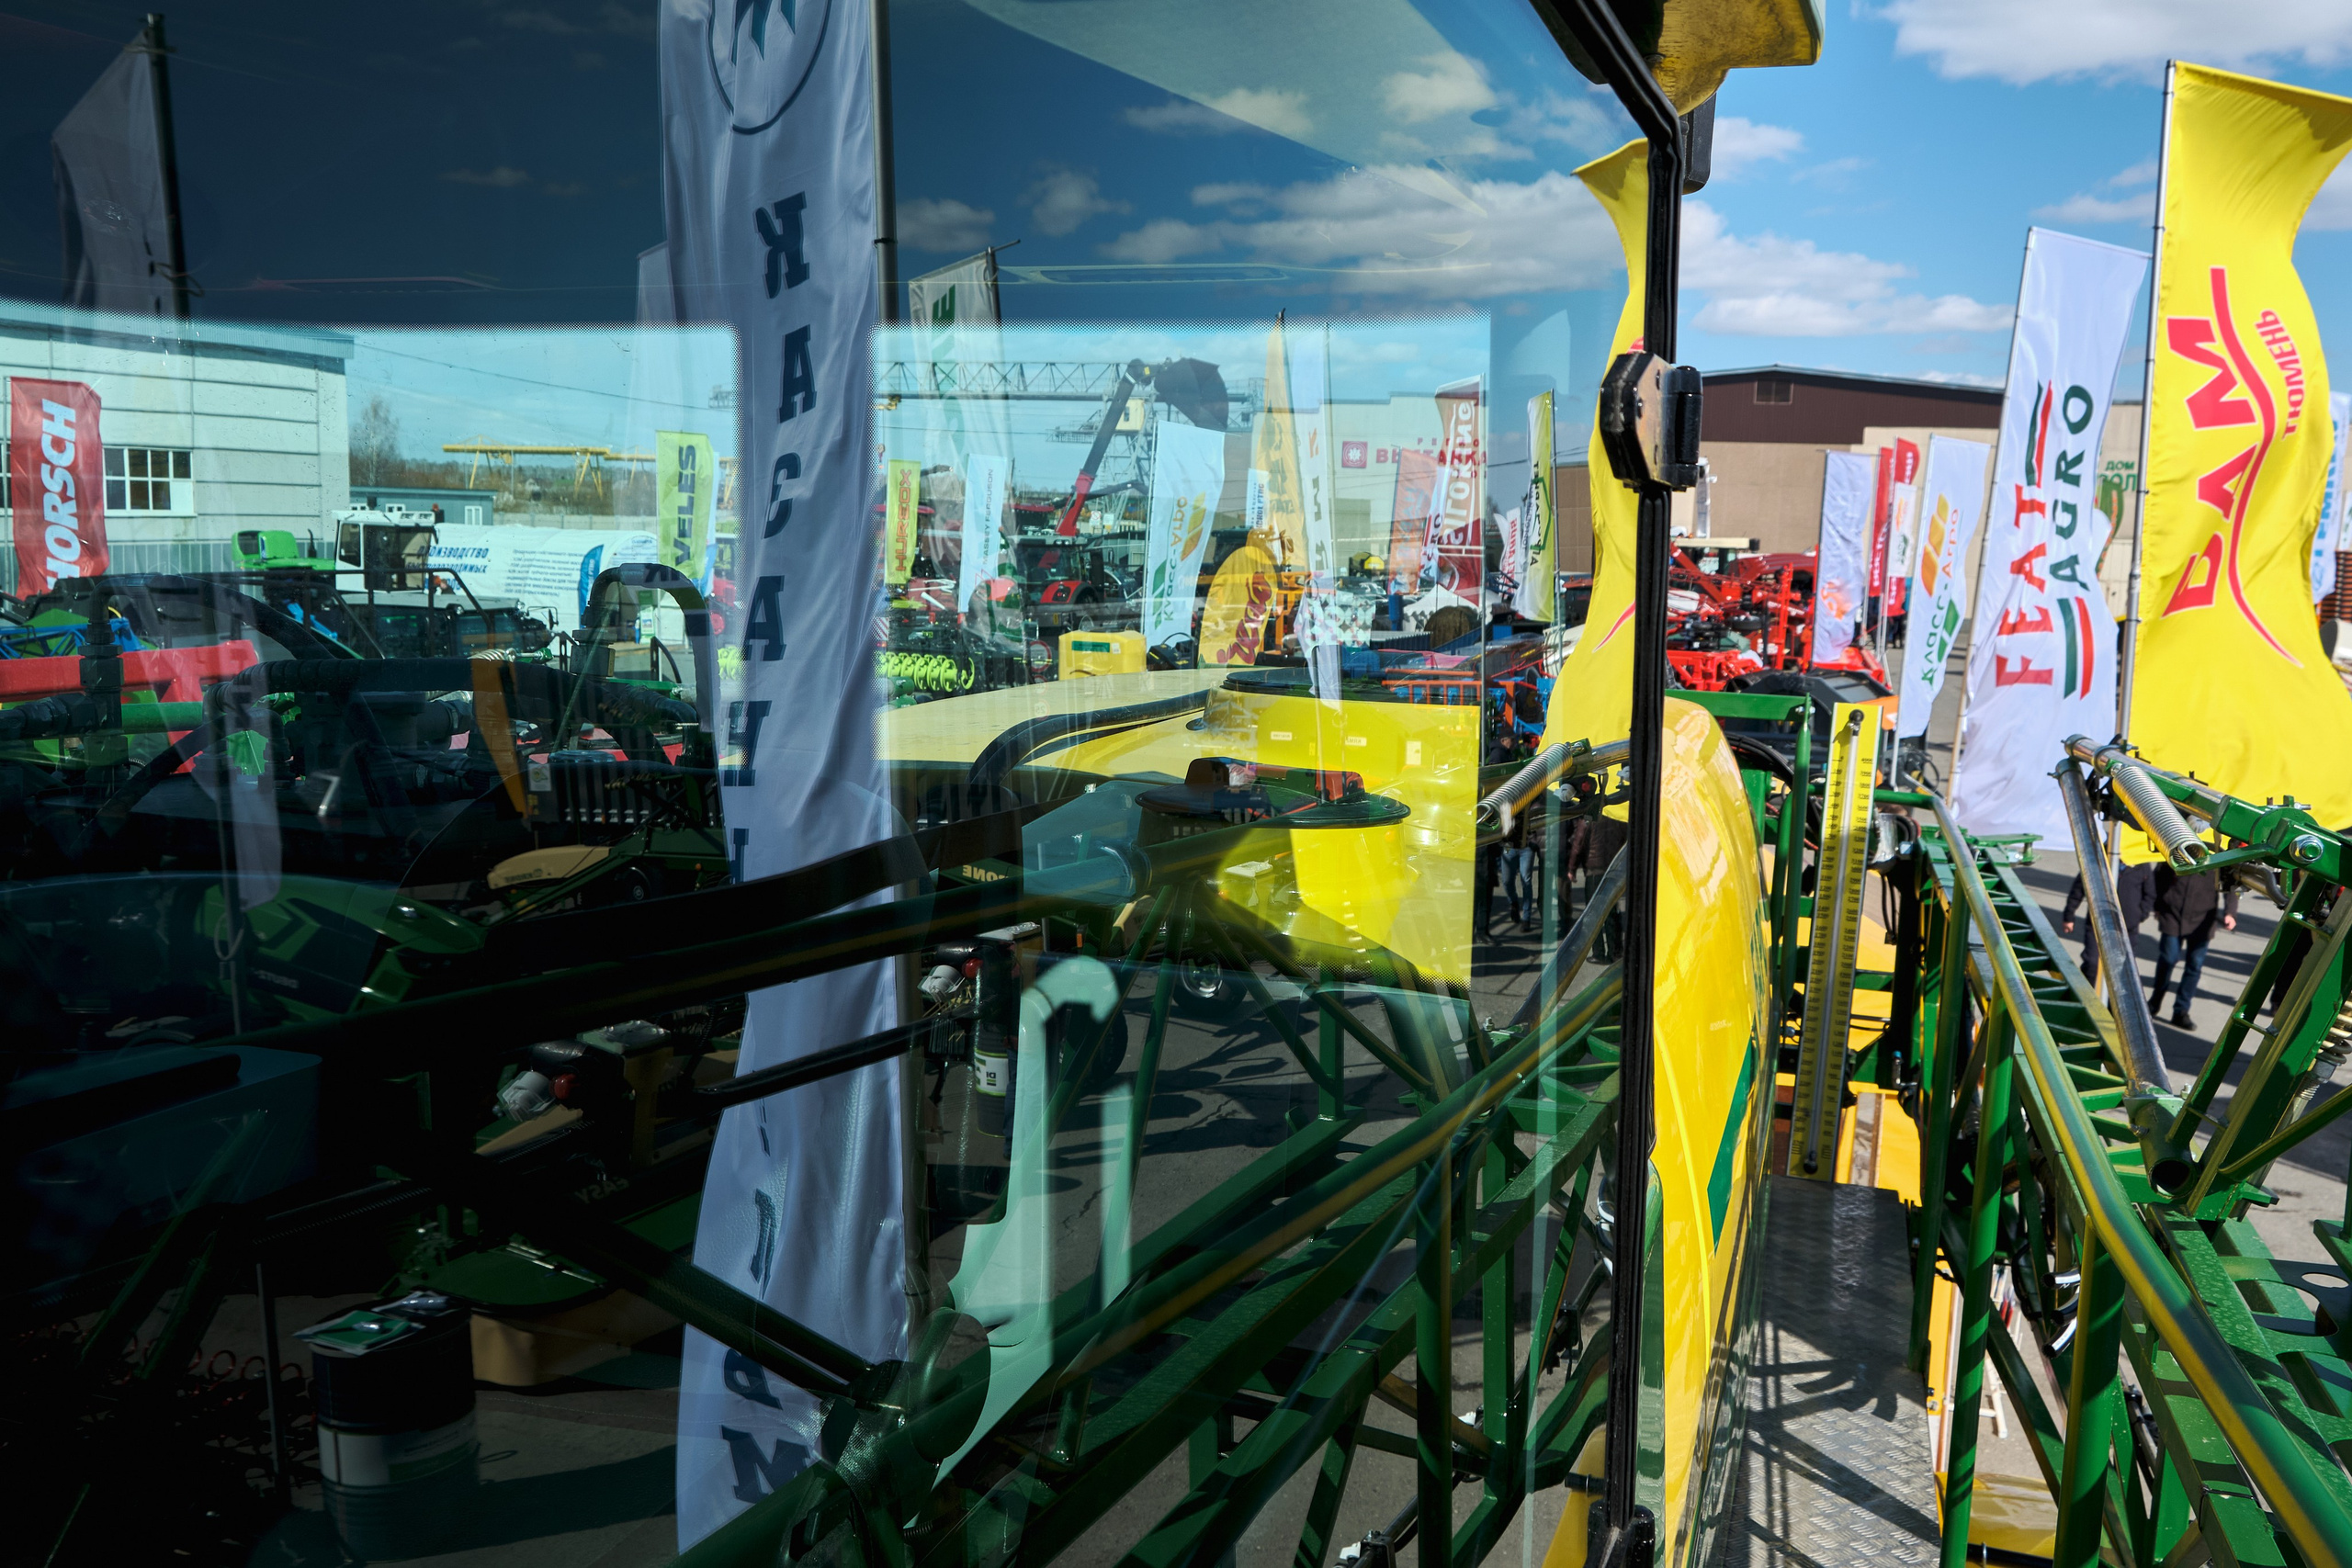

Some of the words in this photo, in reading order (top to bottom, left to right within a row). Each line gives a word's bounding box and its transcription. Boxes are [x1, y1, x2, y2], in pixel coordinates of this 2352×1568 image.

[2255, 310, 2306, 440] ТЮМЕНЬ
[40, 399, 81, 591] HORSCH
[673, 445, 695, 566] VELES
[984, 468, 993, 523] FERGUSON
[2049, 385, 2094, 592] AGRO
[2106, 460, 2135, 471] ДОМ
[2161, 318, 2257, 617] БАМ
[982, 524, 990, 565] MASSEY
[1996, 483, 2053, 687] FEAT
